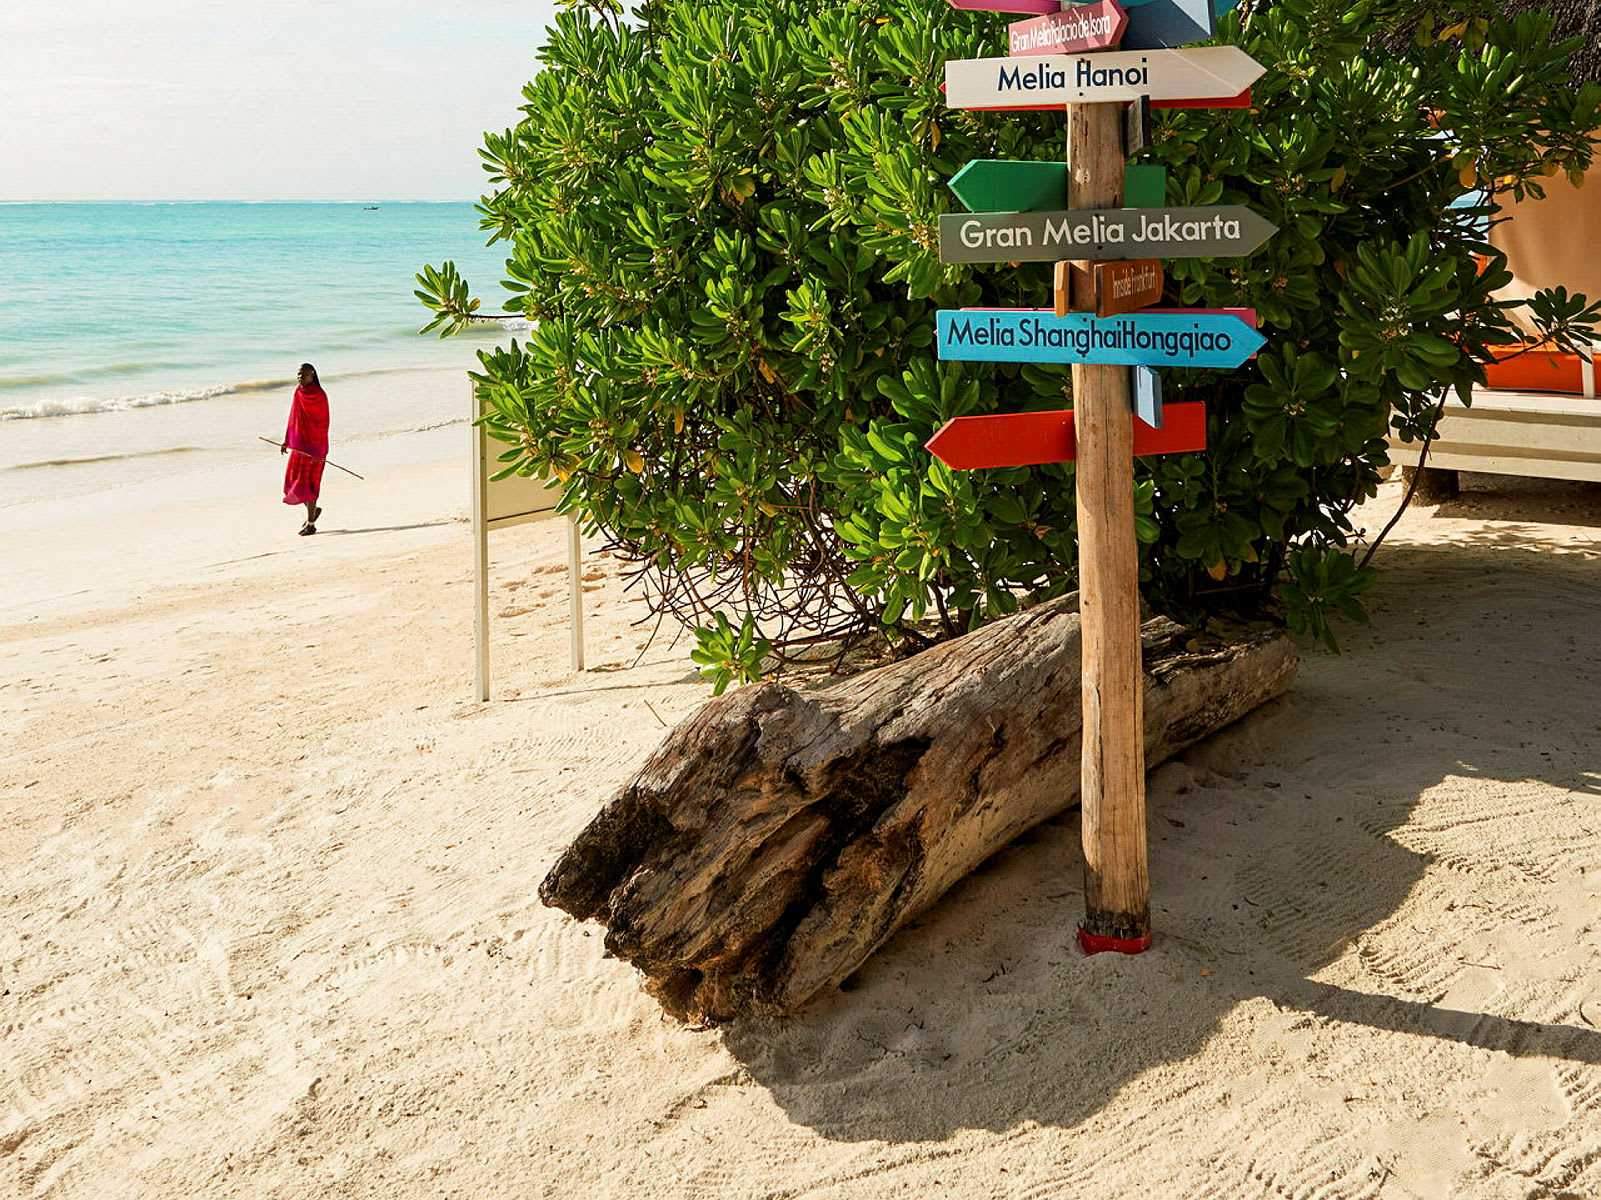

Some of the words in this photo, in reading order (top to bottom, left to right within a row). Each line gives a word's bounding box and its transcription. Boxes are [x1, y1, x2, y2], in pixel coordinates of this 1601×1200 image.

[1078, 12, 1090, 38] de
[998, 65, 1065, 92] Melia
[1077, 59, 1148, 87] Hanoi
[960, 220, 1031, 248] Gran
[1043, 215, 1124, 245] Melia
[1131, 214, 1240, 244] Jakarta
[947, 318, 1014, 346] Melia
